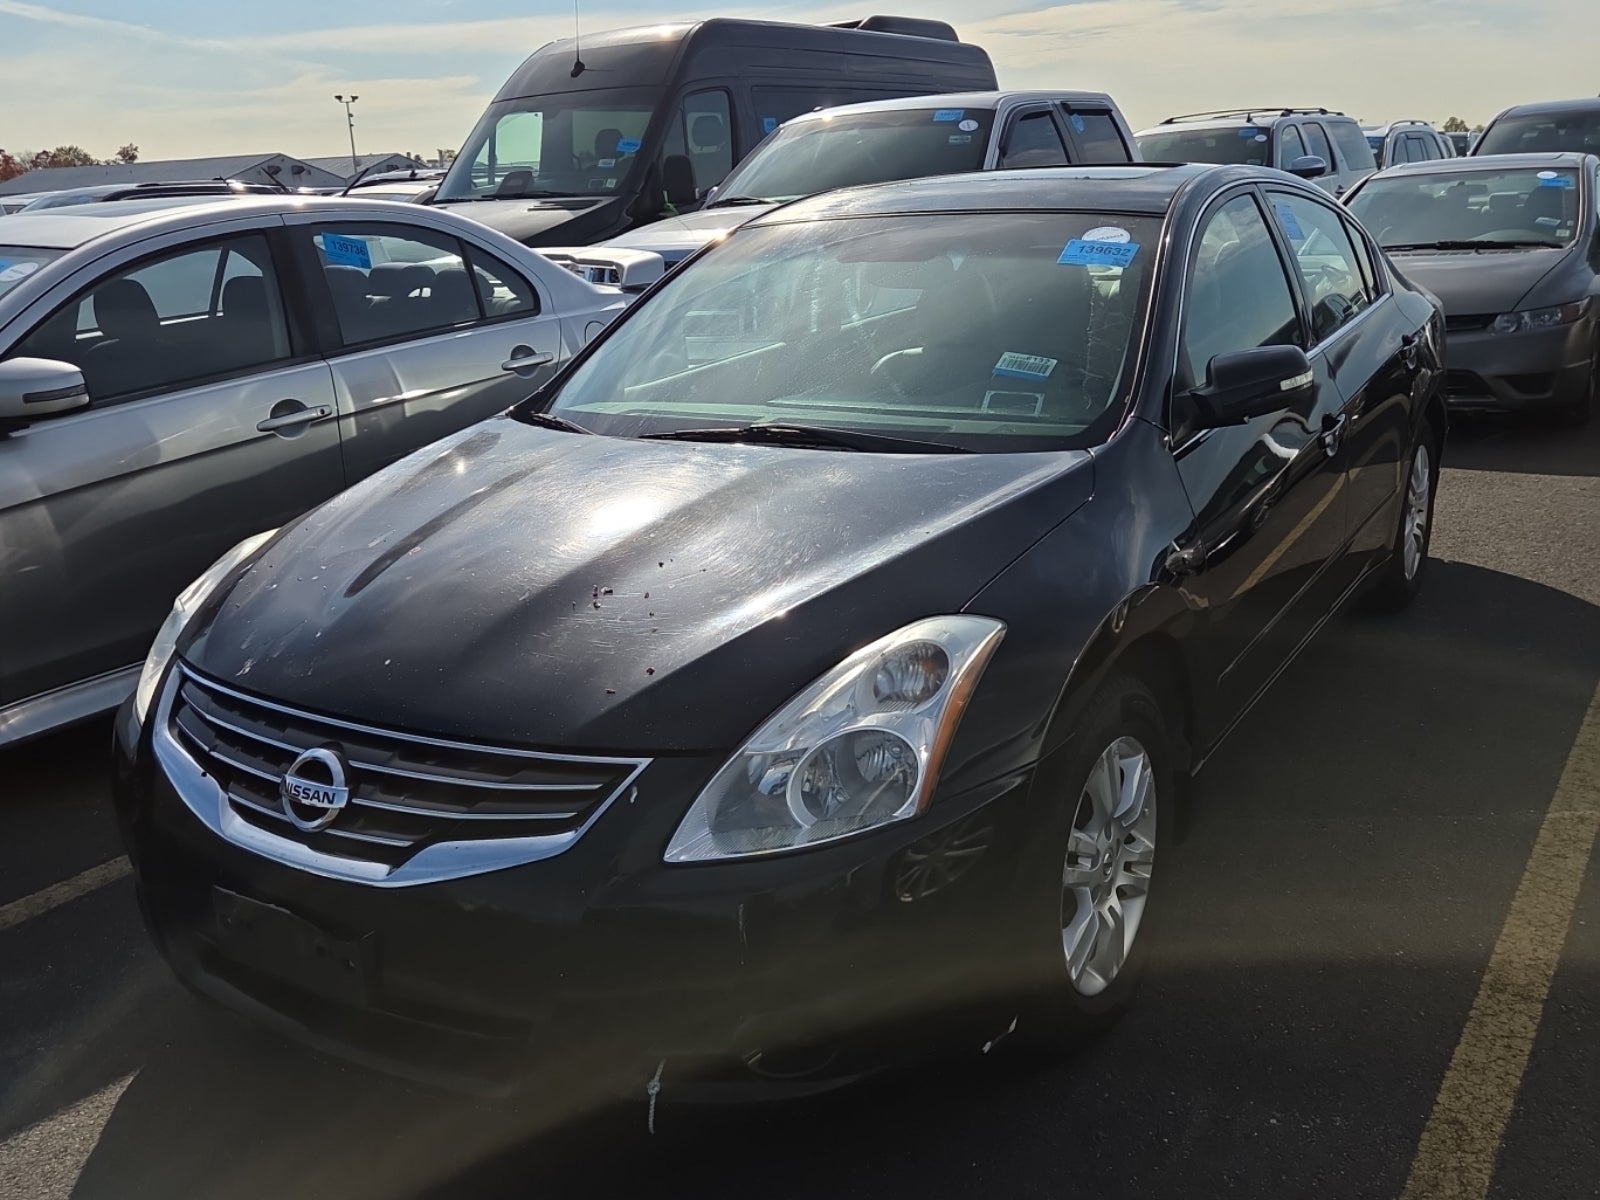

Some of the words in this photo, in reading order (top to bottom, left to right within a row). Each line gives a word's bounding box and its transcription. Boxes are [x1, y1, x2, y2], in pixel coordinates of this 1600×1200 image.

[332, 240, 366, 256] 139736
[1079, 245, 1131, 257] 139632
[285, 780, 336, 805] NISSAN
